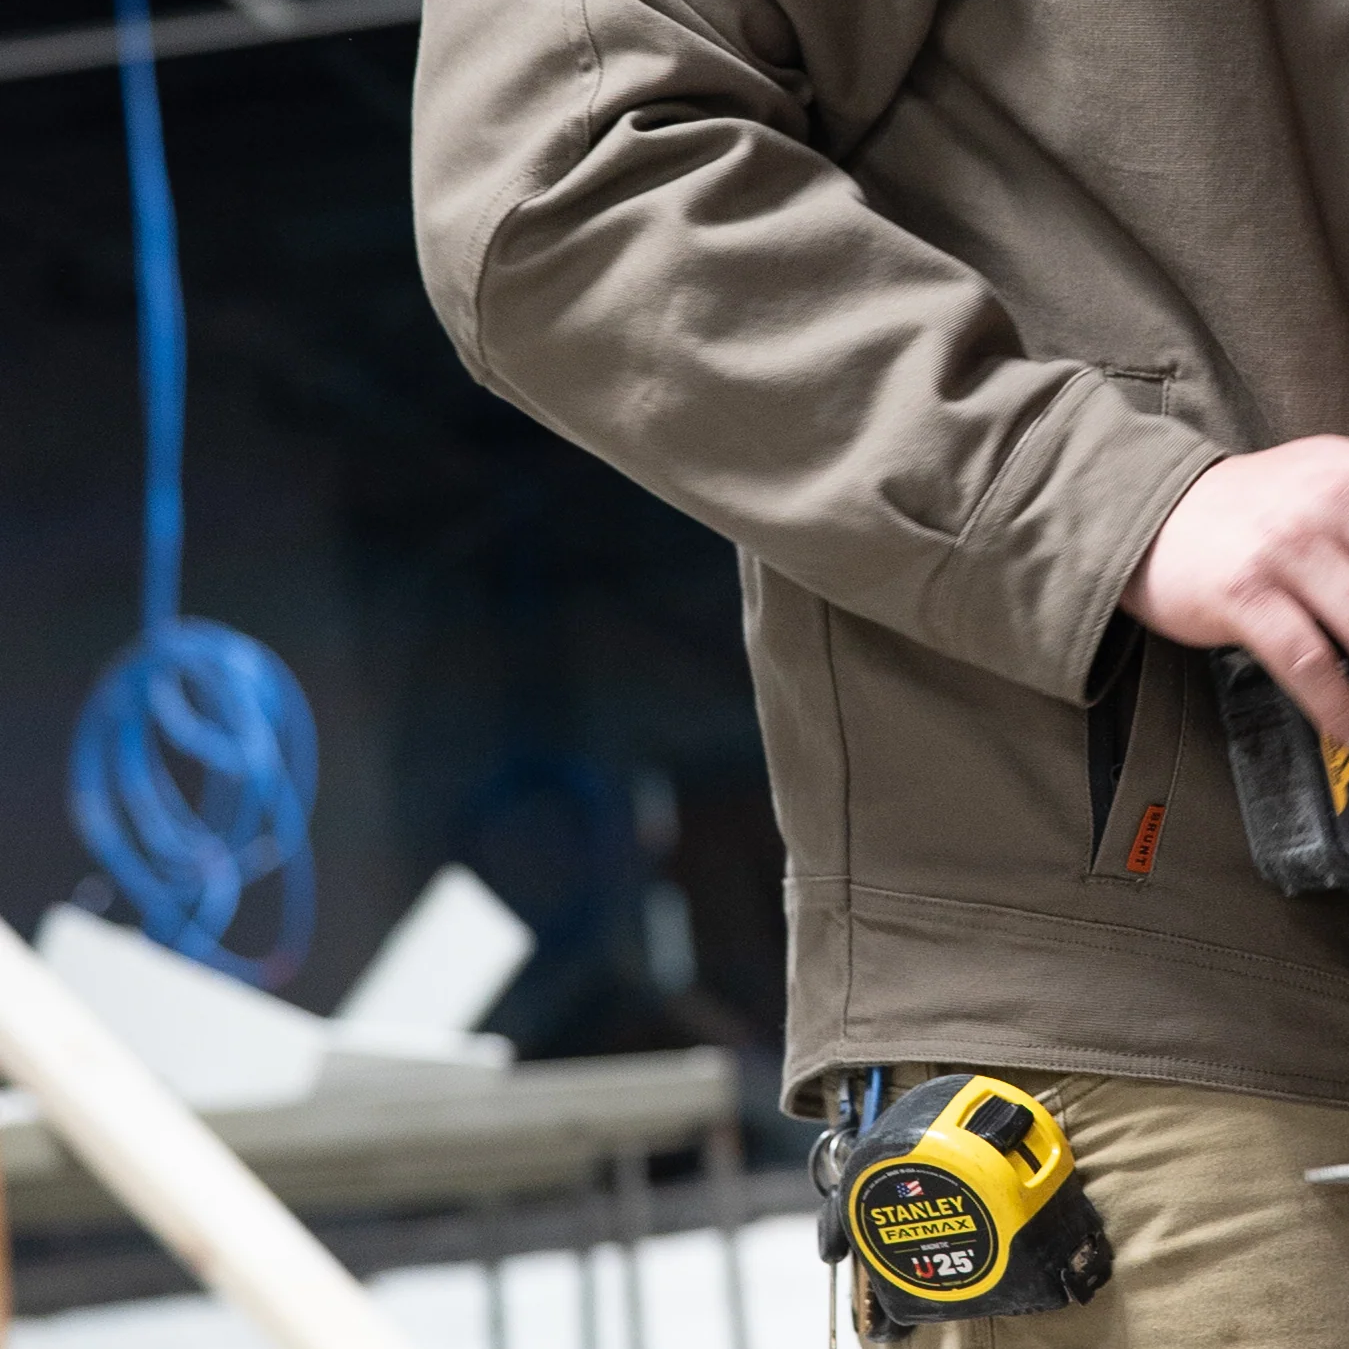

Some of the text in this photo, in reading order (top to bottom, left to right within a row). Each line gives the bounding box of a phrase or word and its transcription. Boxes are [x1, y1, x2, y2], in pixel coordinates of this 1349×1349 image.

[1135, 812, 1162, 867] BRUNT
[871, 1196, 965, 1226] STANLEY
[885, 1218, 970, 1241] FATMAX
[933, 1249, 975, 1276] 25'
